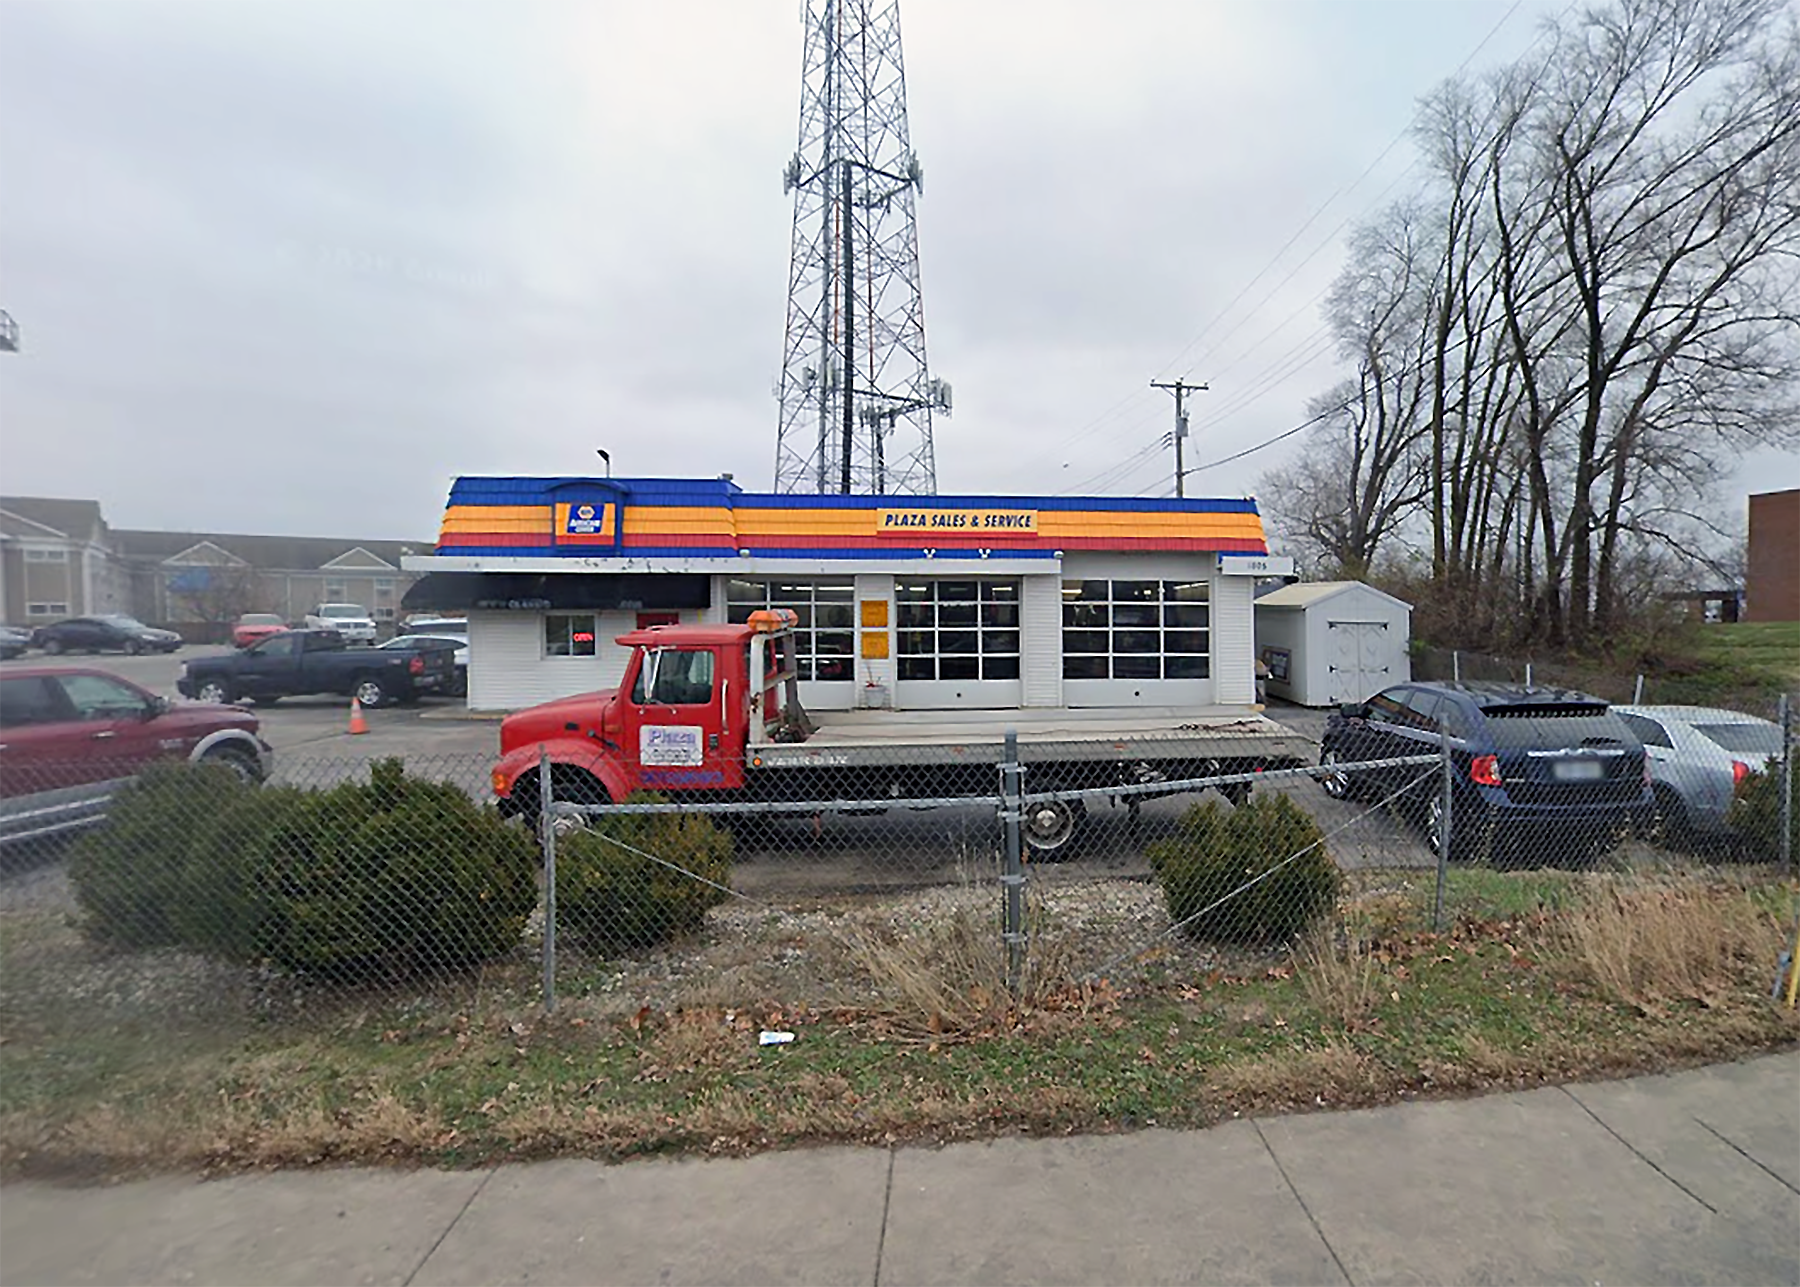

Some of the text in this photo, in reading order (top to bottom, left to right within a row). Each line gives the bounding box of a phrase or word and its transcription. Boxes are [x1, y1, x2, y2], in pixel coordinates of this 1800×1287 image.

[885, 514, 1031, 527] PLAZA SALES & SERVICE
[573, 632, 594, 642] OPEN
